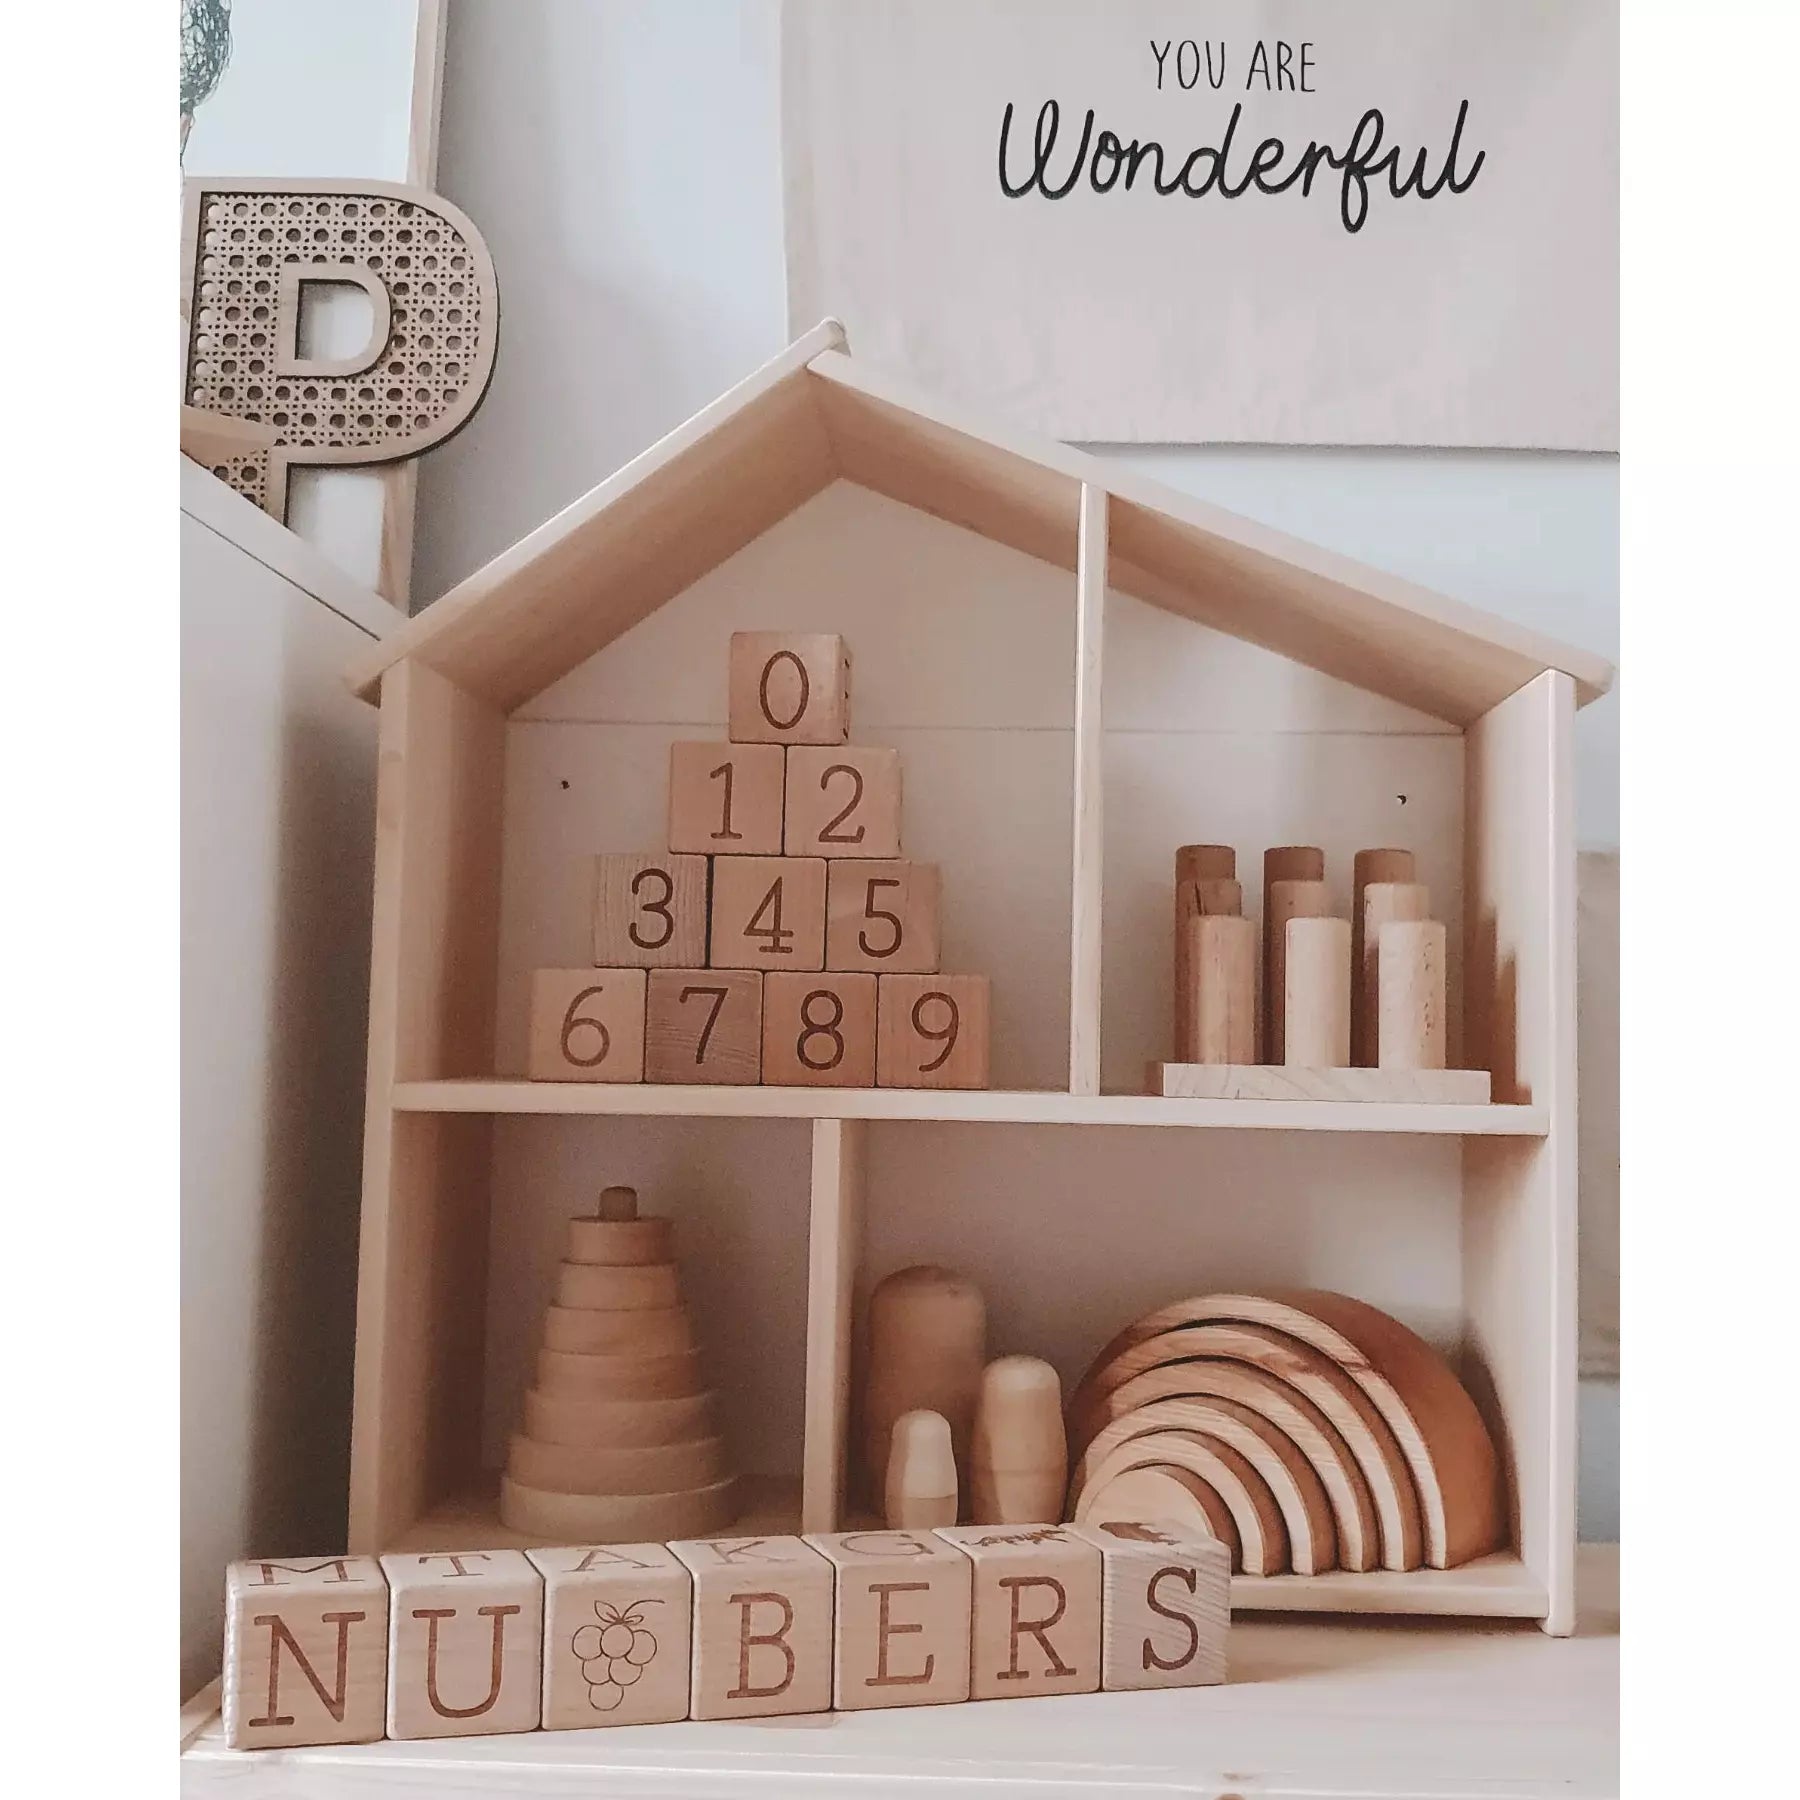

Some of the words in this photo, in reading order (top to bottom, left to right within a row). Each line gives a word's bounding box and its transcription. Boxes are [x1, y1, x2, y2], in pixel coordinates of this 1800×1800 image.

[1150, 40, 1225, 89] YOU
[1246, 41, 1316, 92] ARE
[998, 99, 1486, 233] Wonderful
